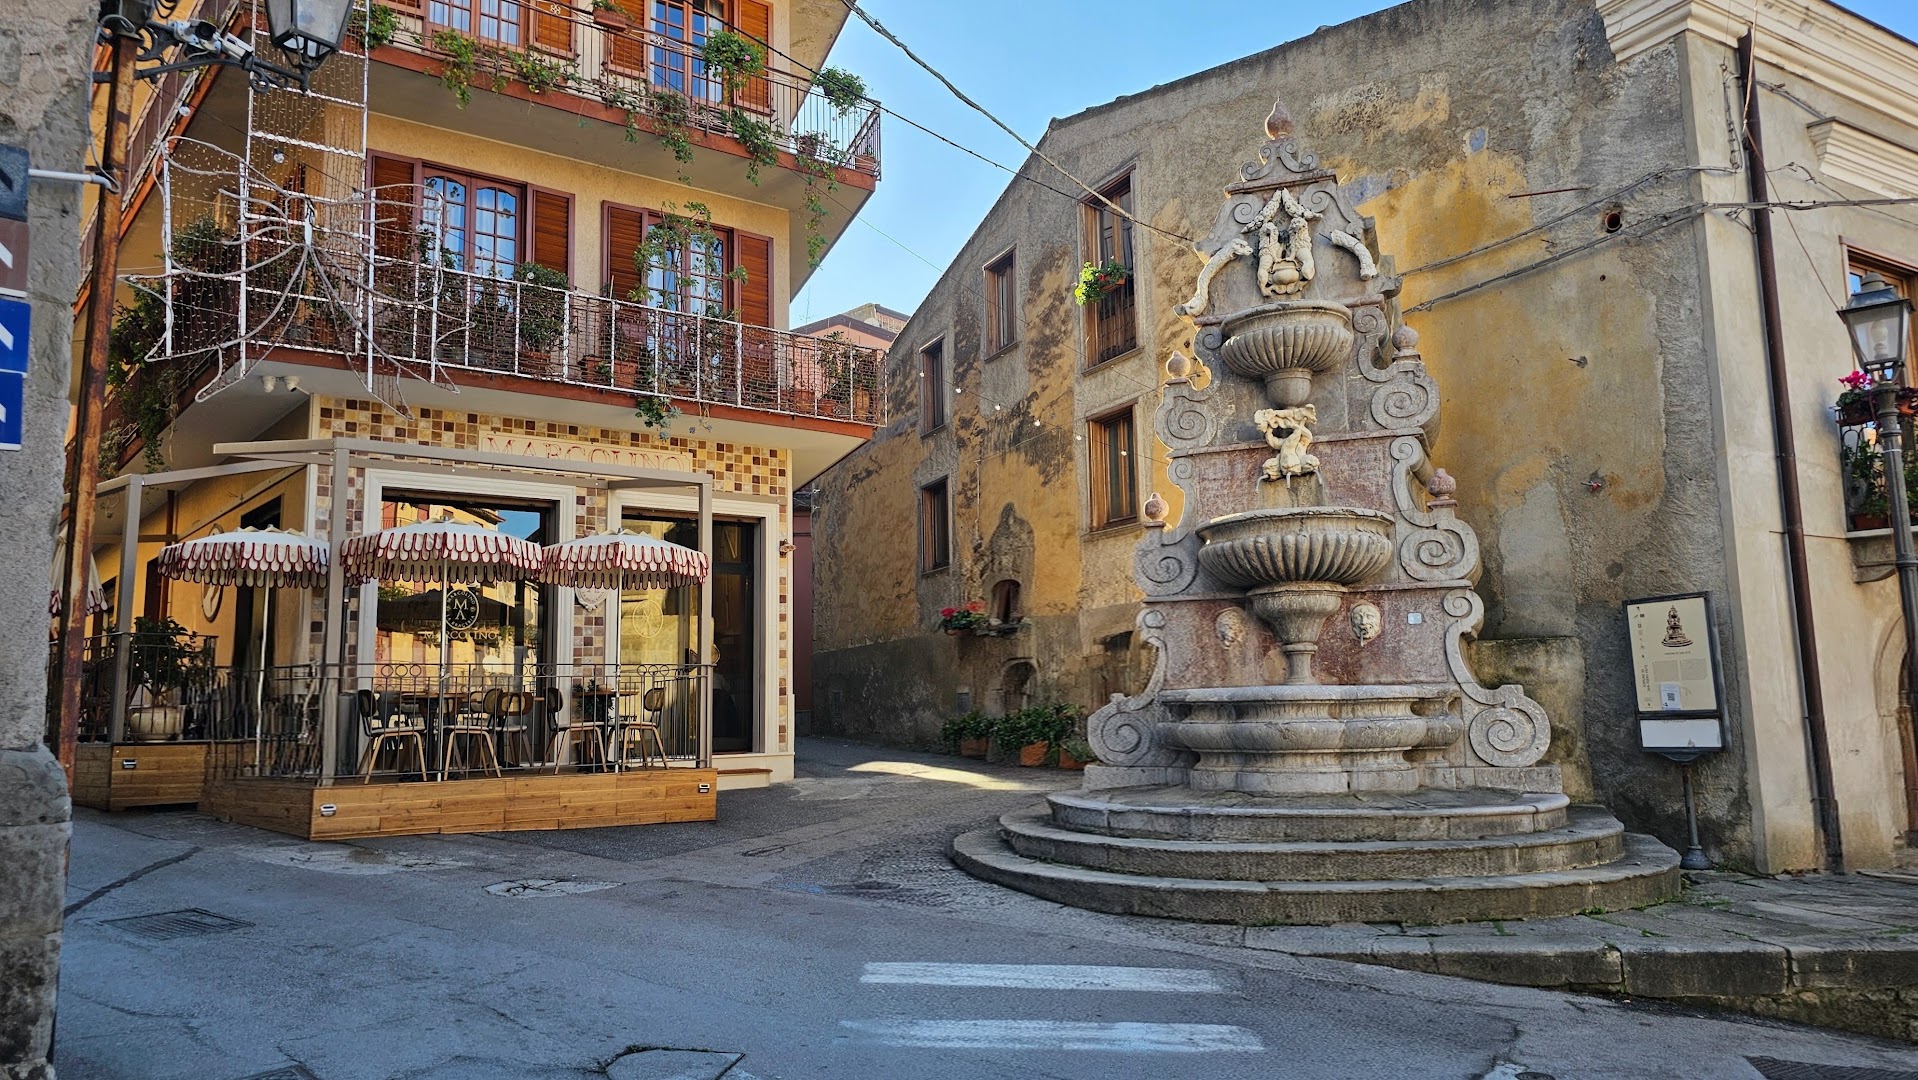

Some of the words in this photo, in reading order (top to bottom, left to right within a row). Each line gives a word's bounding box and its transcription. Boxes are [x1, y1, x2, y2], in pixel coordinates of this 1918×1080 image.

[486, 437, 685, 473] MARCOLINO
[446, 590, 476, 605] MARCOLINO
[423, 630, 497, 640] MRCOLINO
